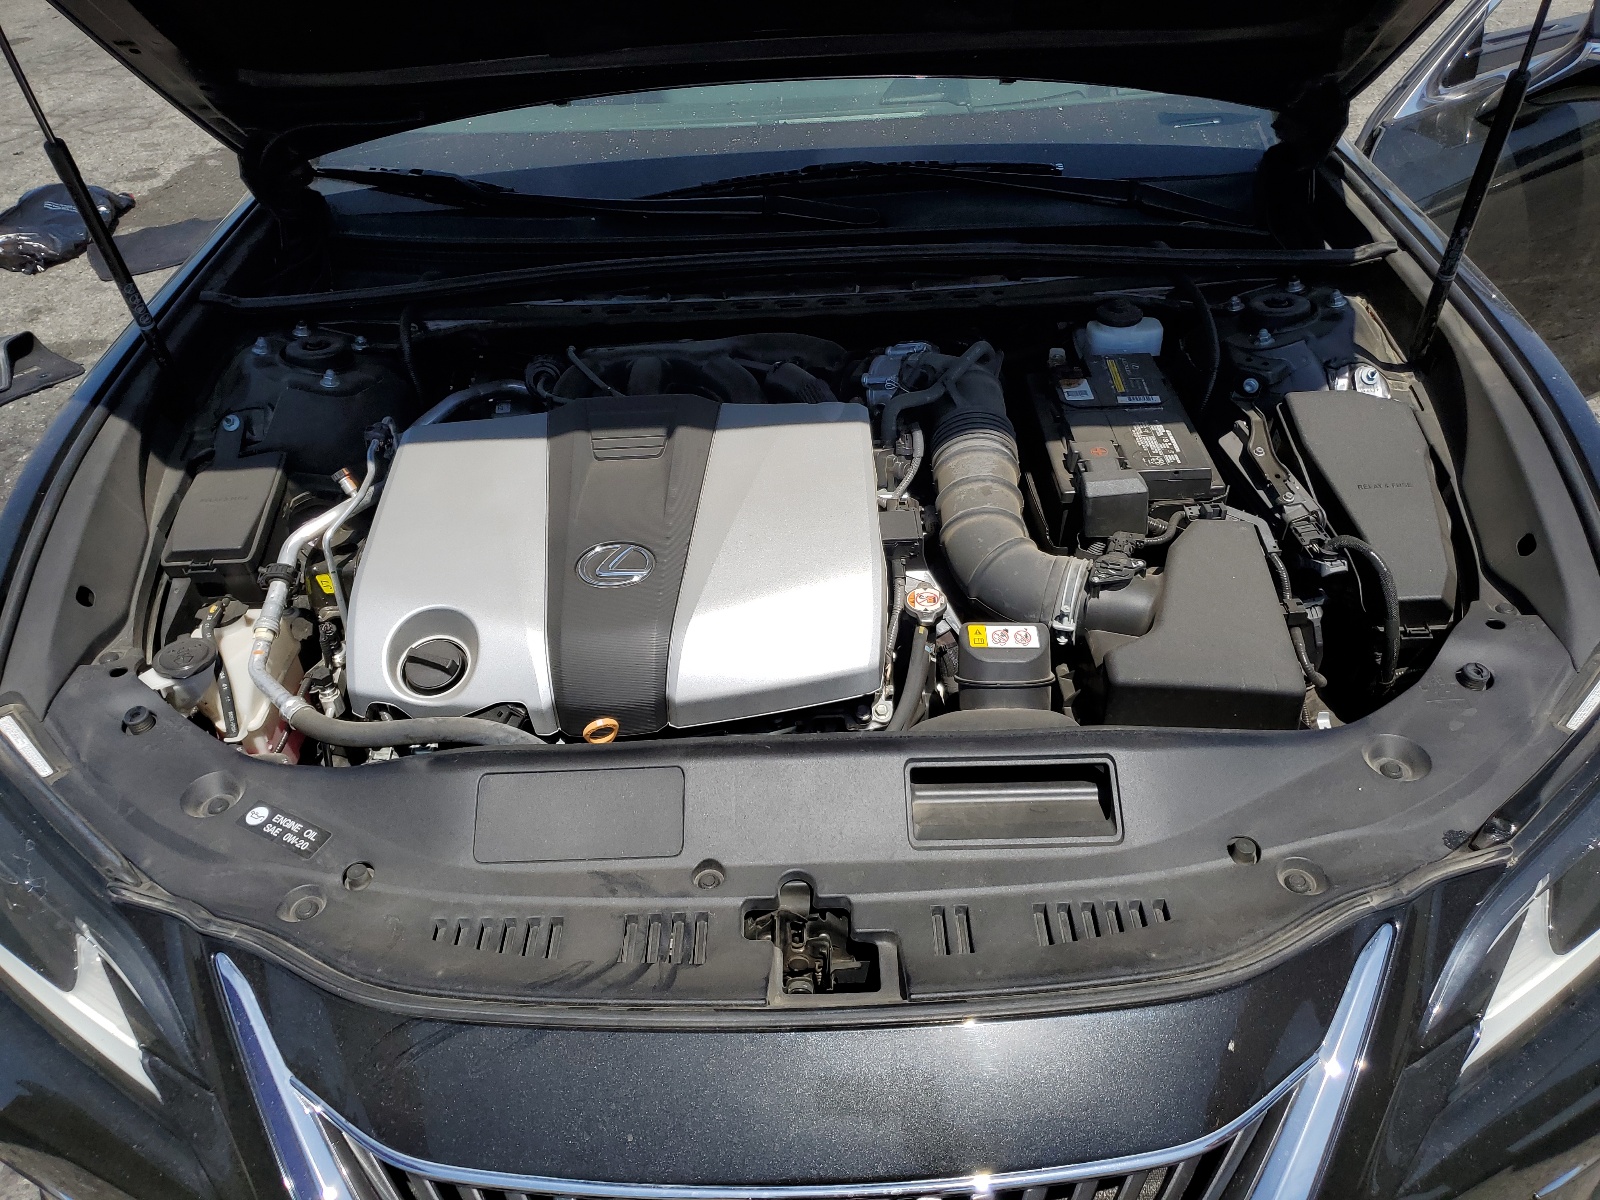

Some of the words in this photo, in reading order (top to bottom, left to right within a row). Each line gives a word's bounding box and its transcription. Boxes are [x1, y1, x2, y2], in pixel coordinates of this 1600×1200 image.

[1357, 482, 1383, 490] RELAY
[262, 823, 283, 837] SAE
[282, 832, 310, 850] 0W-20
[271, 813, 304, 833] ENGINE
[303, 829, 318, 842] OIL
